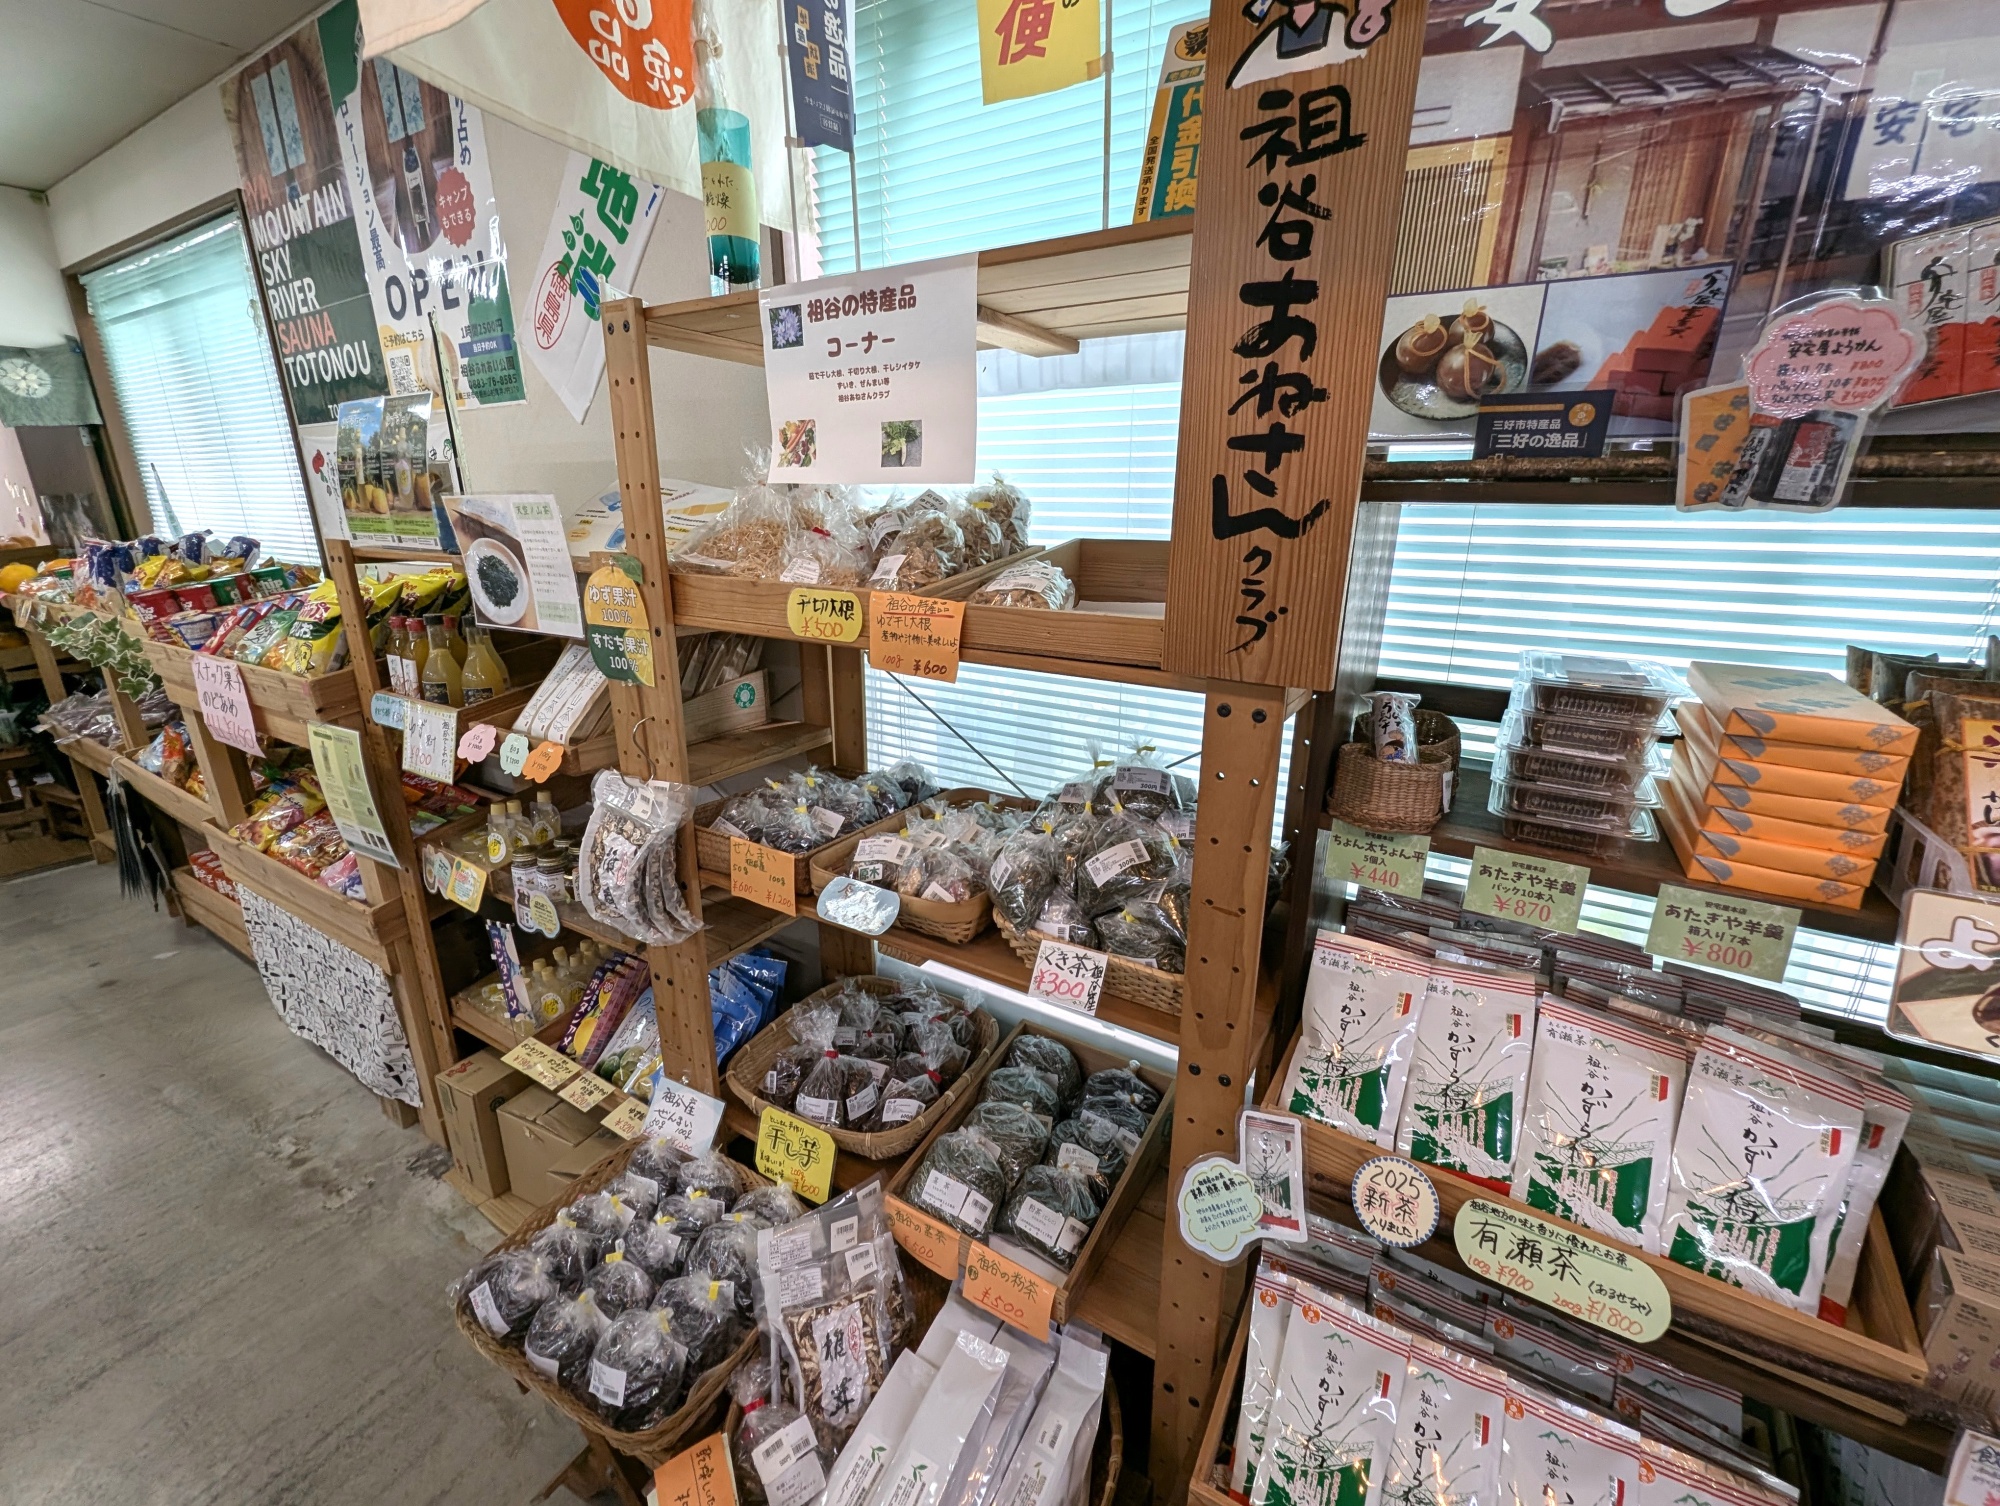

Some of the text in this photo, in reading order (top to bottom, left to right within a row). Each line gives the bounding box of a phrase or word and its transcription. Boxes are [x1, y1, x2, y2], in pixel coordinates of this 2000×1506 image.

[338, 99, 387, 272] ロケーション最高
[1137, 135, 1159, 216] 全国発送承ります
[438, 185, 468, 209] キャンプ
[251, 179, 347, 251] MOUNTAIN
[441, 209, 473, 229] もできる
[261, 244, 293, 287] SKY
[385, 250, 486, 321] OPEN
[268, 277, 320, 321] RIVER
[806, 284, 917, 324] 祖谷の特産品
[278, 311, 337, 355] SAUNA
[383, 328, 425, 348] ご予約はこちら
[461, 318, 503, 339] 1時間2500円
[826, 330, 897, 359] コーナー
[284, 340, 371, 388] TOTONOU
[460, 356, 516, 378] 祖谷ふれあい公園
[1212, 84, 1369, 655] 祖谷あねさんクラブ
[1491, 418, 1562, 431] 三好市特産品
[1488, 431, 1589, 449] 「三好の逸品」
[588, 584, 638, 608] ゆず果汁
[886, 594, 950, 615] 祖谷の特産品
[601, 607, 632, 624] 100%
[800, 616, 844, 639] ¥500
[876, 615, 932, 633] ゆで干し大根
[592, 632, 649, 656] すだち果汁
[609, 655, 639, 673] 100%
[195, 662, 242, 694] スナック菓子
[202, 690, 239, 718] のどあめ
[409, 746, 432, 766] ¥900
[1140, 783, 1158, 791] 300円
[732, 841, 777, 863] ぜんまい
[1332, 833, 1426, 862] ちょん太ちょん平
[1362, 853, 1388, 867] 5個入
[732, 864, 786, 885] 50g 100g
[858, 867, 880, 881] 原木
[1117, 857, 1137, 871] 300円
[1349, 861, 1401, 888] ¥440
[1478, 863, 1579, 898] あたぎや羊羹
[1491, 882, 1557, 905] パック10本入
[1492, 893, 1552, 923] ¥870
[1704, 900, 1748, 916] 安宅屋本店
[1664, 903, 1786, 941] あたぎや羊羹
[1687, 924, 1752, 947] 箱入り 7本
[1318, 955, 1351, 971] 有瀬茶
[1681, 936, 1754, 970] ¥800
[492, 937, 518, 1011] ボンタンアメ
[1036, 968, 1085, 999] ¥300
[559, 977, 600, 1046] ボンタンアメ
[1546, 1026, 1587, 1048] 有瀬茶
[1698, 1060, 1746, 1089] 有瀬茶
[661, 1086, 699, 1116] 祖谷産
[613, 1117, 635, 1134] ¥320
[653, 1107, 694, 1129] ぜんまい
[674, 1127, 693, 1140] 100g
[765, 1125, 821, 1171] 干し芋
[792, 1178, 821, 1197] ¥600
[1369, 1164, 1423, 1200] 2025
[1362, 1185, 1417, 1226] 新茶
[1369, 1214, 1421, 1240] 入りました!
[1469, 1217, 1583, 1287] 有瀬茶
[975, 1250, 1040, 1304] 祖谷の粉茶
[1466, 1253, 1586, 1316] 100g ¥900 200g
[979, 1286, 1025, 1319] ¥500
